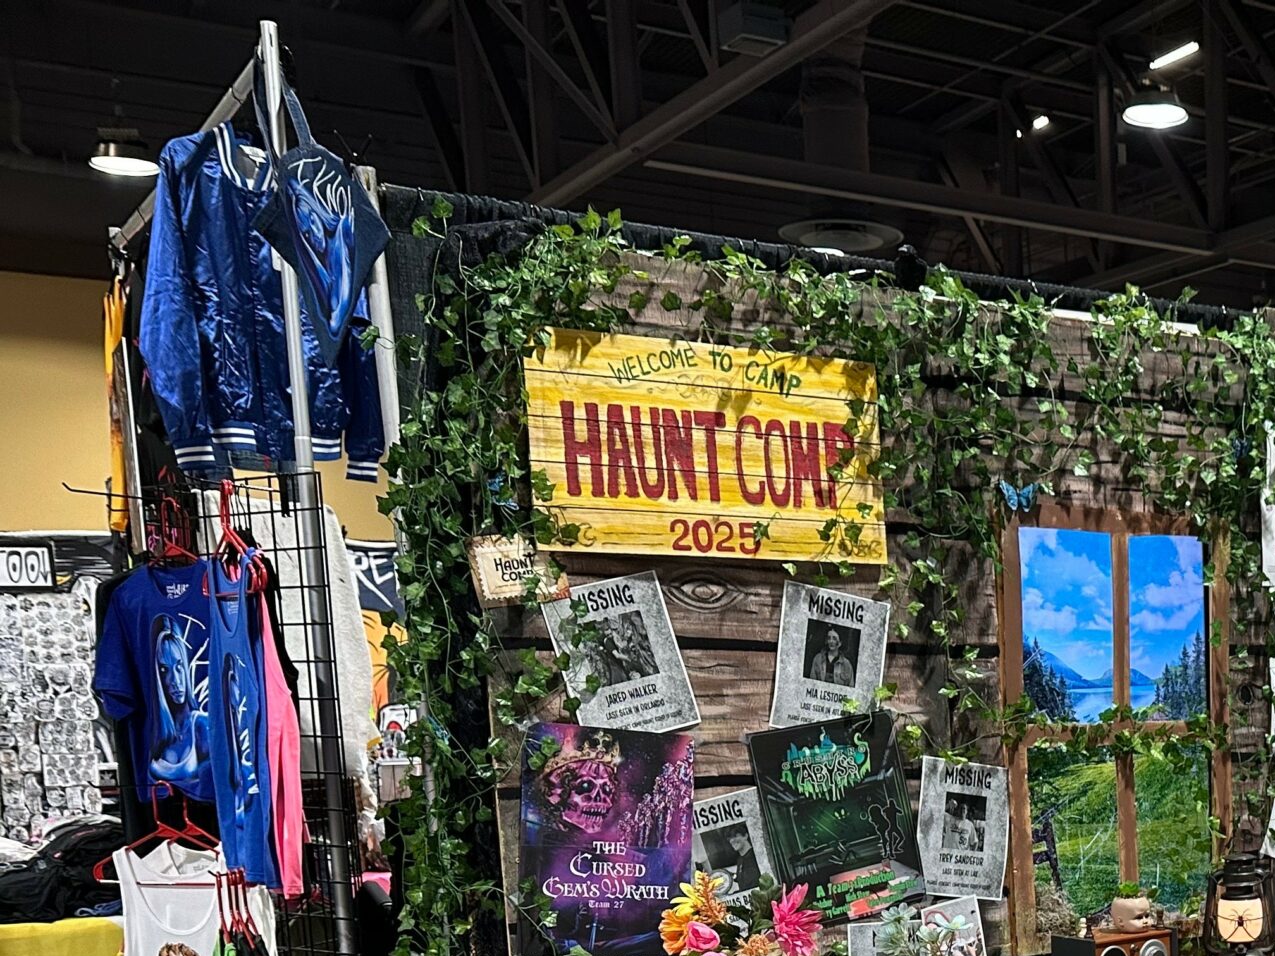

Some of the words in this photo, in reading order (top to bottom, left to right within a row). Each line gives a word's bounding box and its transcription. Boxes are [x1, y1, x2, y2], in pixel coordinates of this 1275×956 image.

[608, 347, 698, 385] WELCOME
[708, 350, 733, 373] TO
[745, 360, 802, 398] CAMP
[559, 400, 726, 503] HAUNT
[735, 415, 856, 510] COMP
[669, 519, 762, 555] 2025
[494, 552, 536, 573] HAUNT
[808, 593, 865, 625] MISSING
[605, 692, 627, 707] JARED
[628, 683, 659, 699] WALKER
[806, 688, 818, 699] MIA
[606, 710, 617, 720] LAST
[619, 706, 632, 717] SEEN
[799, 754, 862, 787] ABYSS
[944, 766, 993, 790] MISSING
[693, 799, 743, 829] ISSING
[593, 841, 627, 855] THE
[939, 852, 953, 863] TREY
[955, 854, 984, 866] SANDEFUR
[569, 852, 646, 877] CURSED
[542, 876, 600, 899] GEM'S
[601, 879, 669, 900] WRATH
[816, 885, 825, 898] A
[588, 900, 610, 909] Team
[614, 900, 625, 909] 27
